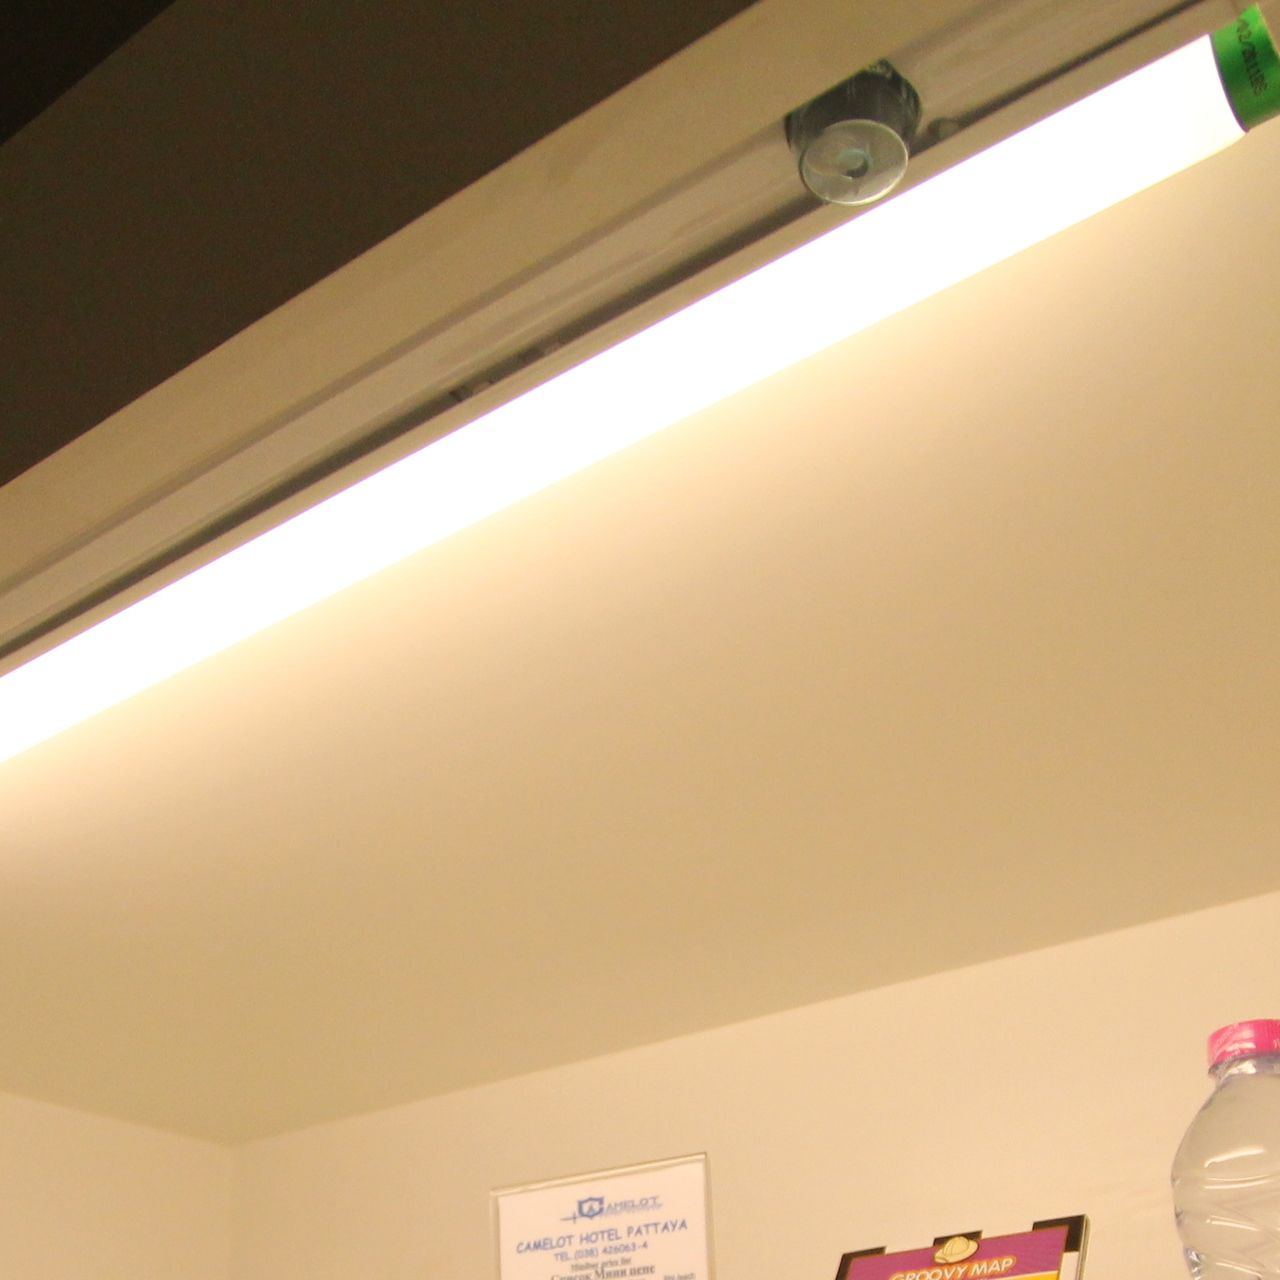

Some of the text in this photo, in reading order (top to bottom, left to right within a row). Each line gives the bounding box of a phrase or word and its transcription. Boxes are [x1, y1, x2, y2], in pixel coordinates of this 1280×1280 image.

[516, 1218, 688, 1255] CAMELOT HOTEL PATTAYA
[574, 1247, 599, 1261] (038)
[970, 1257, 1015, 1277] MAP
